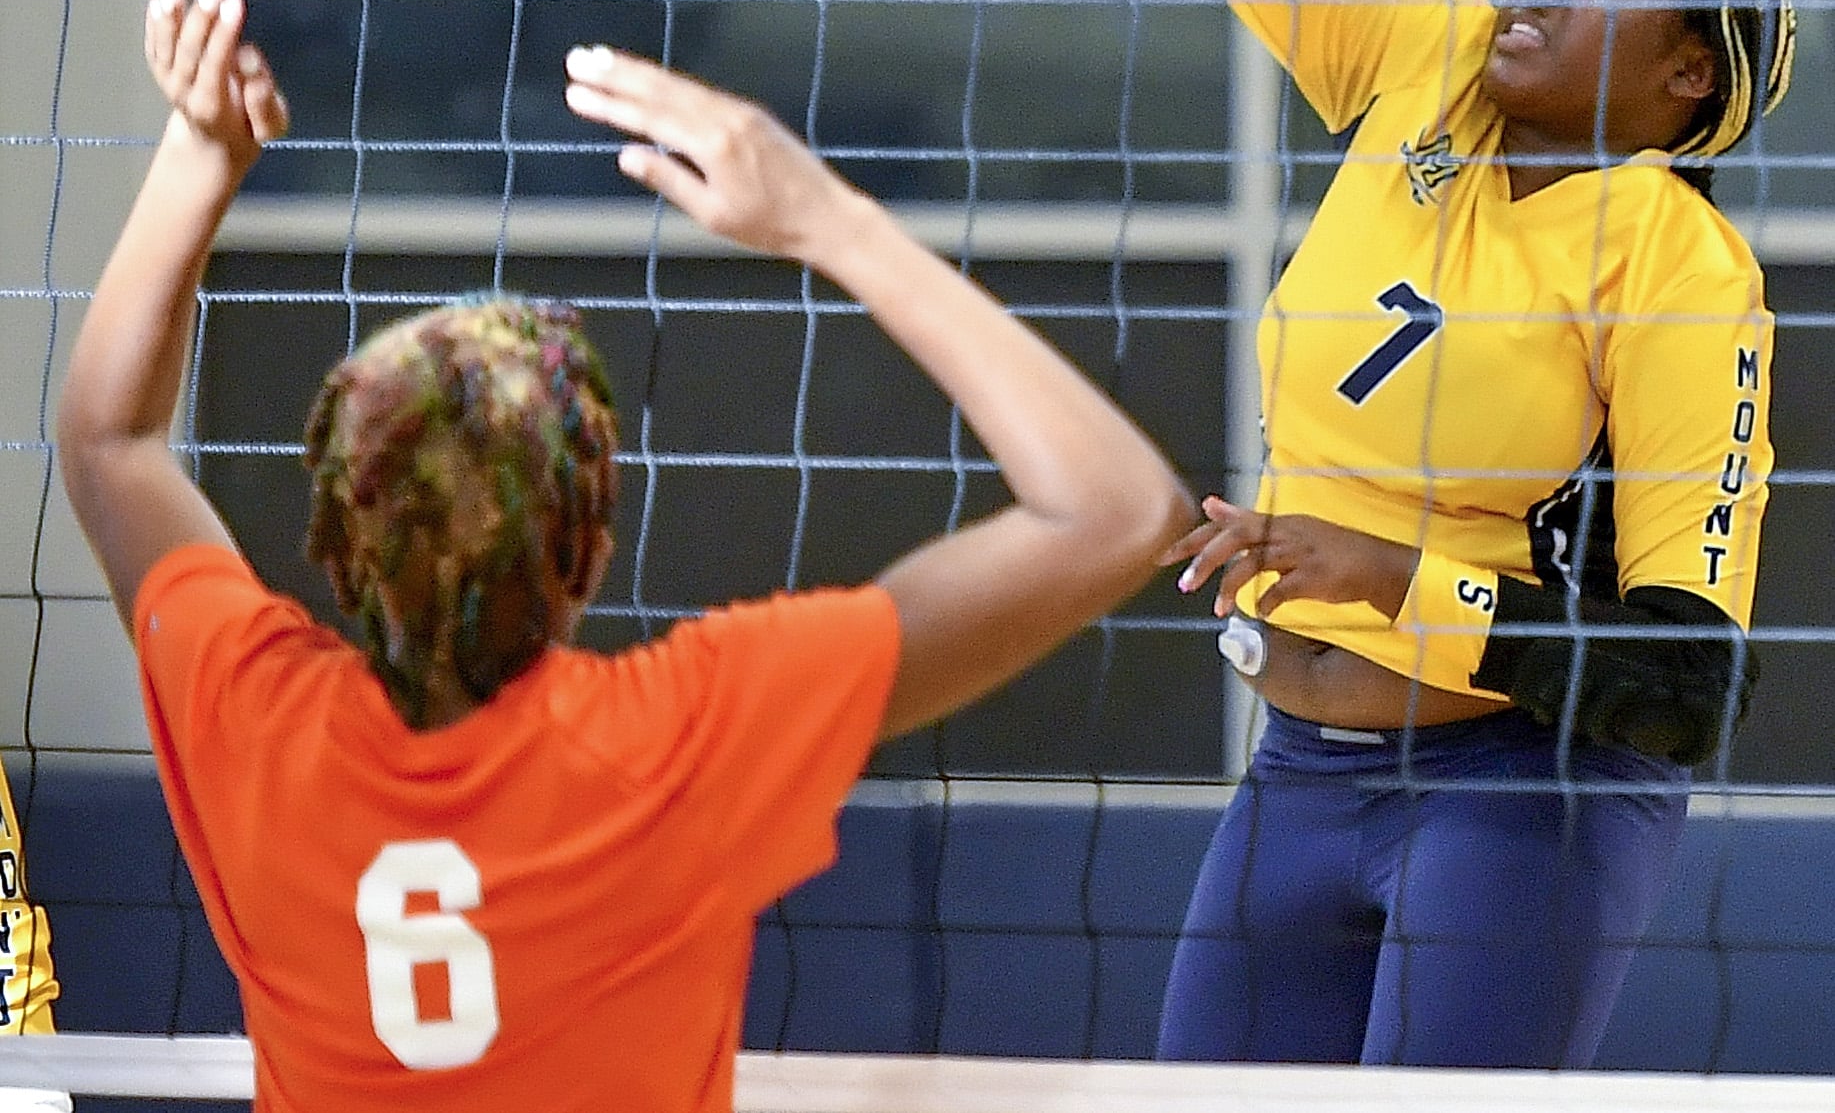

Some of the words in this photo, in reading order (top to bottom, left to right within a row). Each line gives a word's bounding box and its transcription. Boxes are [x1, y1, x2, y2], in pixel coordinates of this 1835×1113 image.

[1337, 281, 1444, 406] 7
[1703, 347, 1760, 586] MOUNT
[356, 838, 500, 1070] 6
